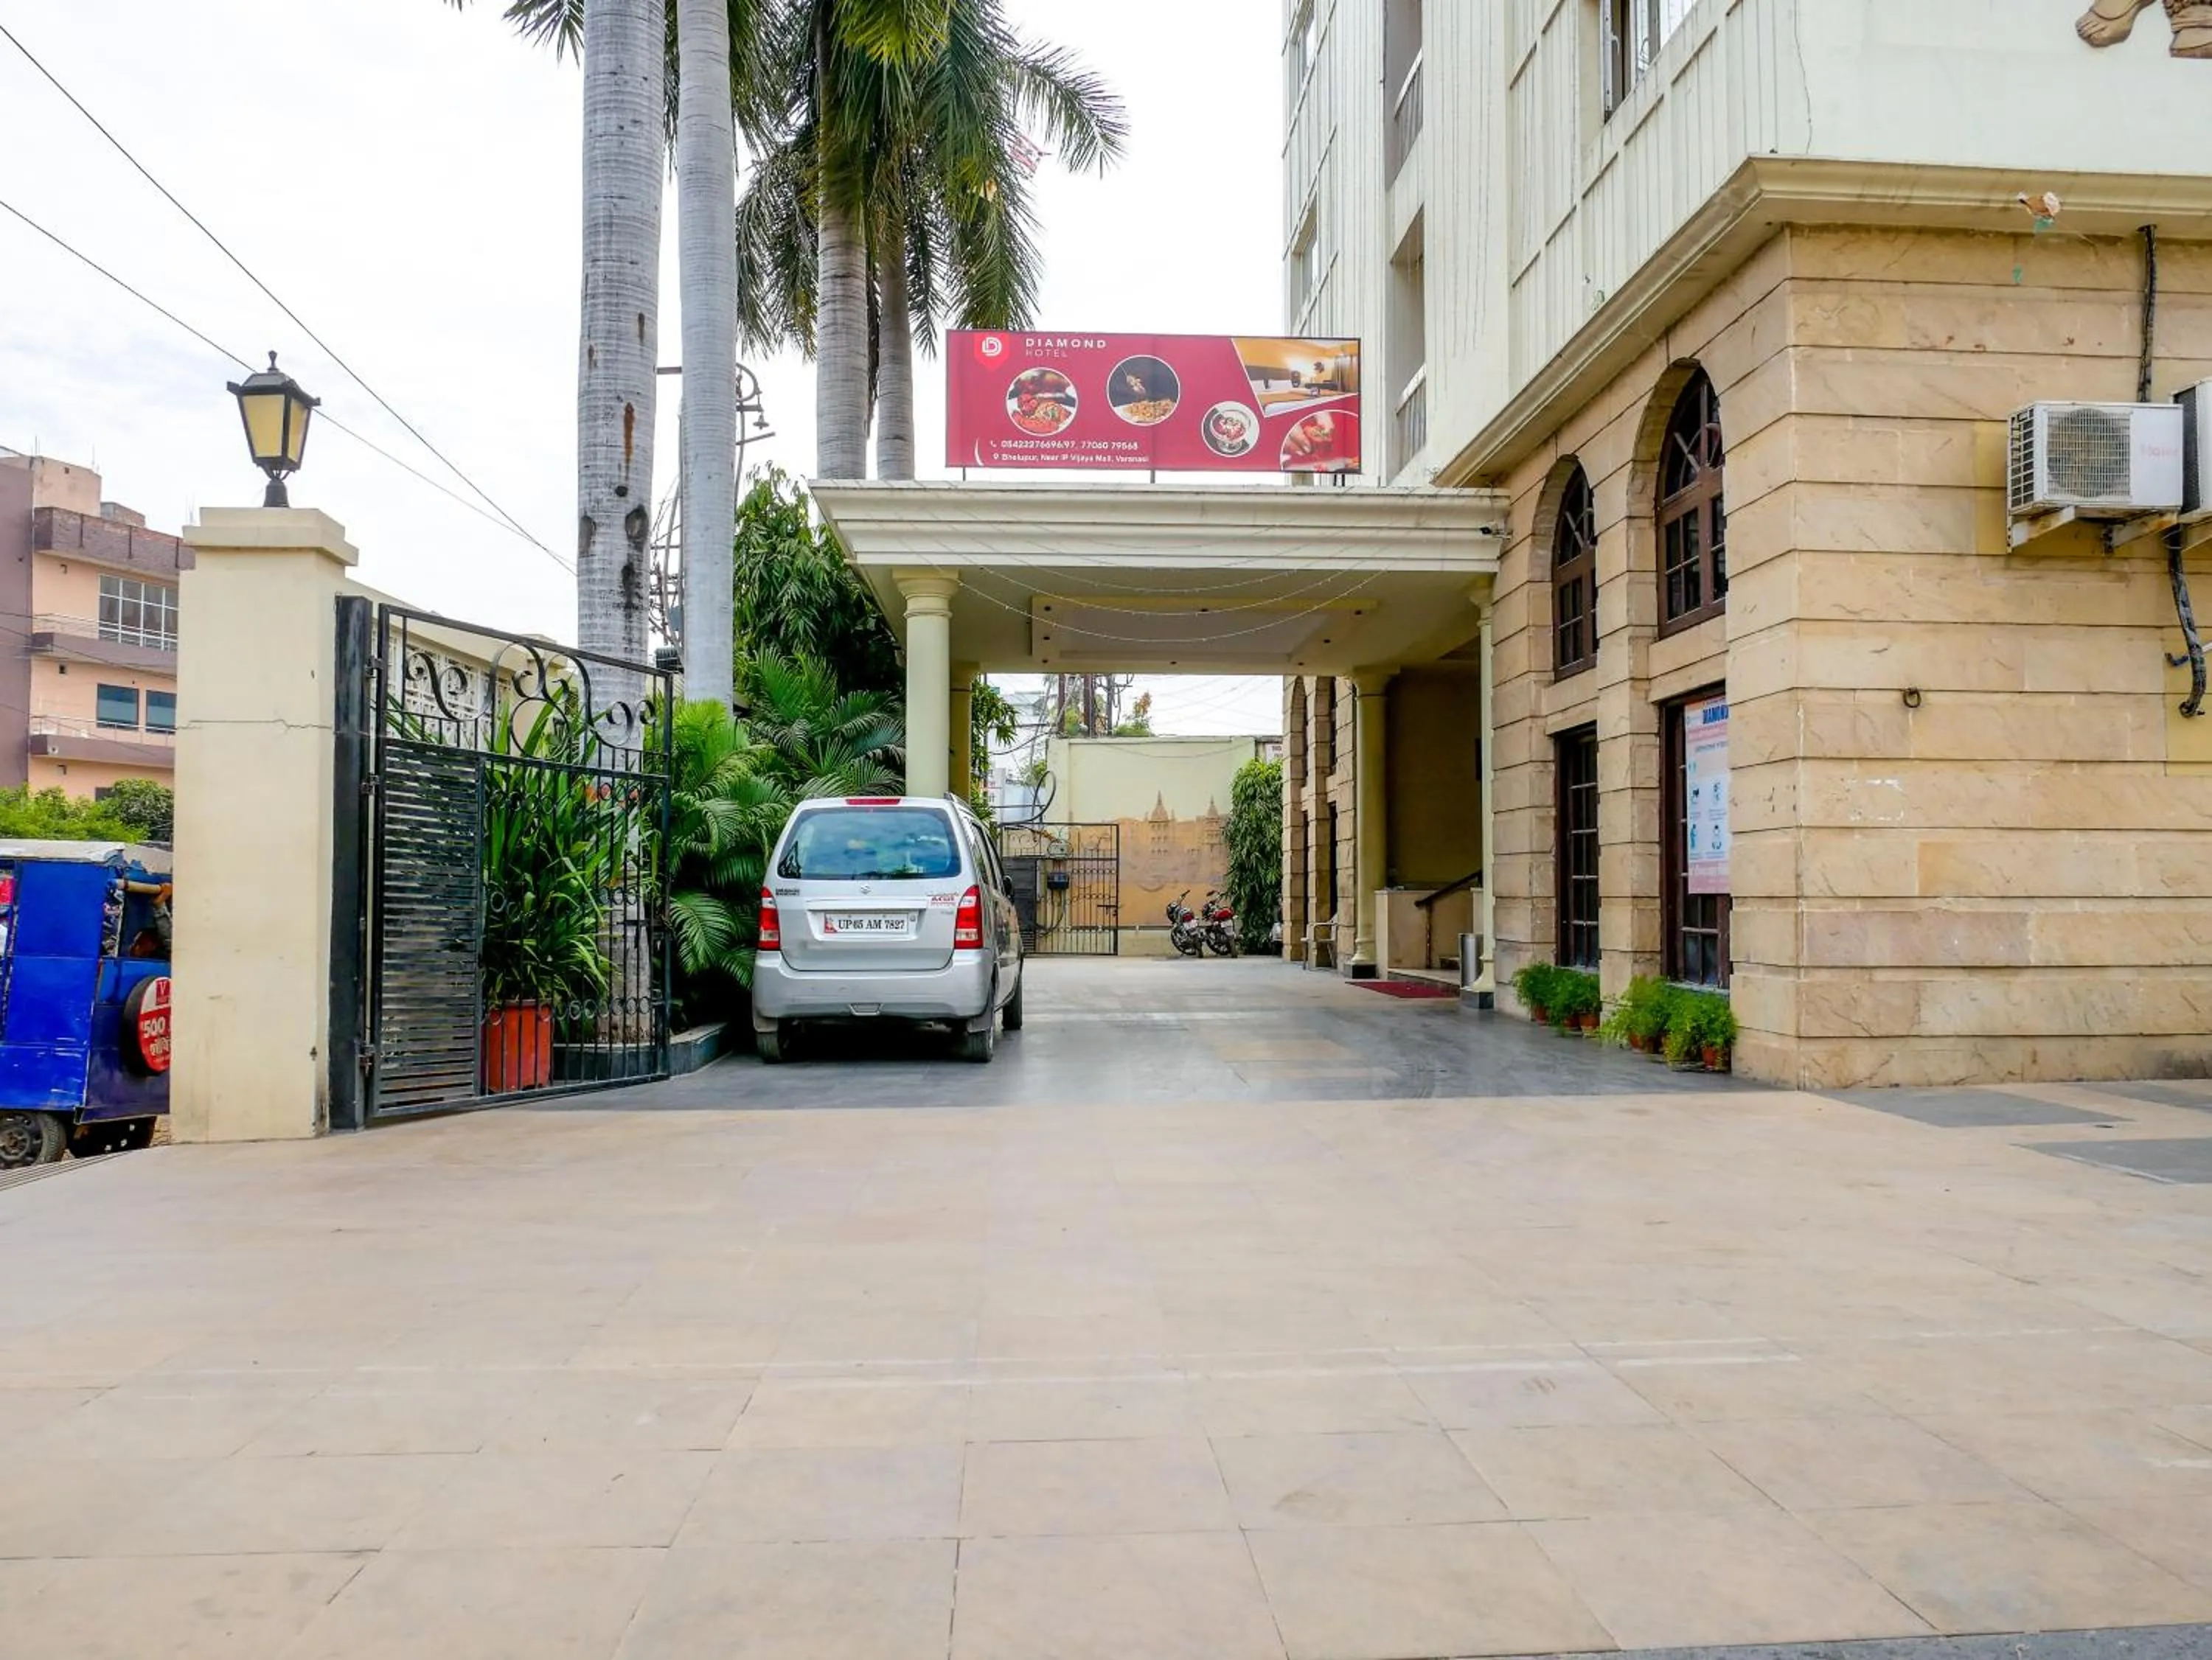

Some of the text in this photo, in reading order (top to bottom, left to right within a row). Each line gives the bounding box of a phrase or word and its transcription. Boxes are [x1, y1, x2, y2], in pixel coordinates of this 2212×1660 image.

[1026, 338, 1107, 349] DIAMOND
[1026, 349, 1068, 358] HOTEL
[865, 919, 883, 930] AM
